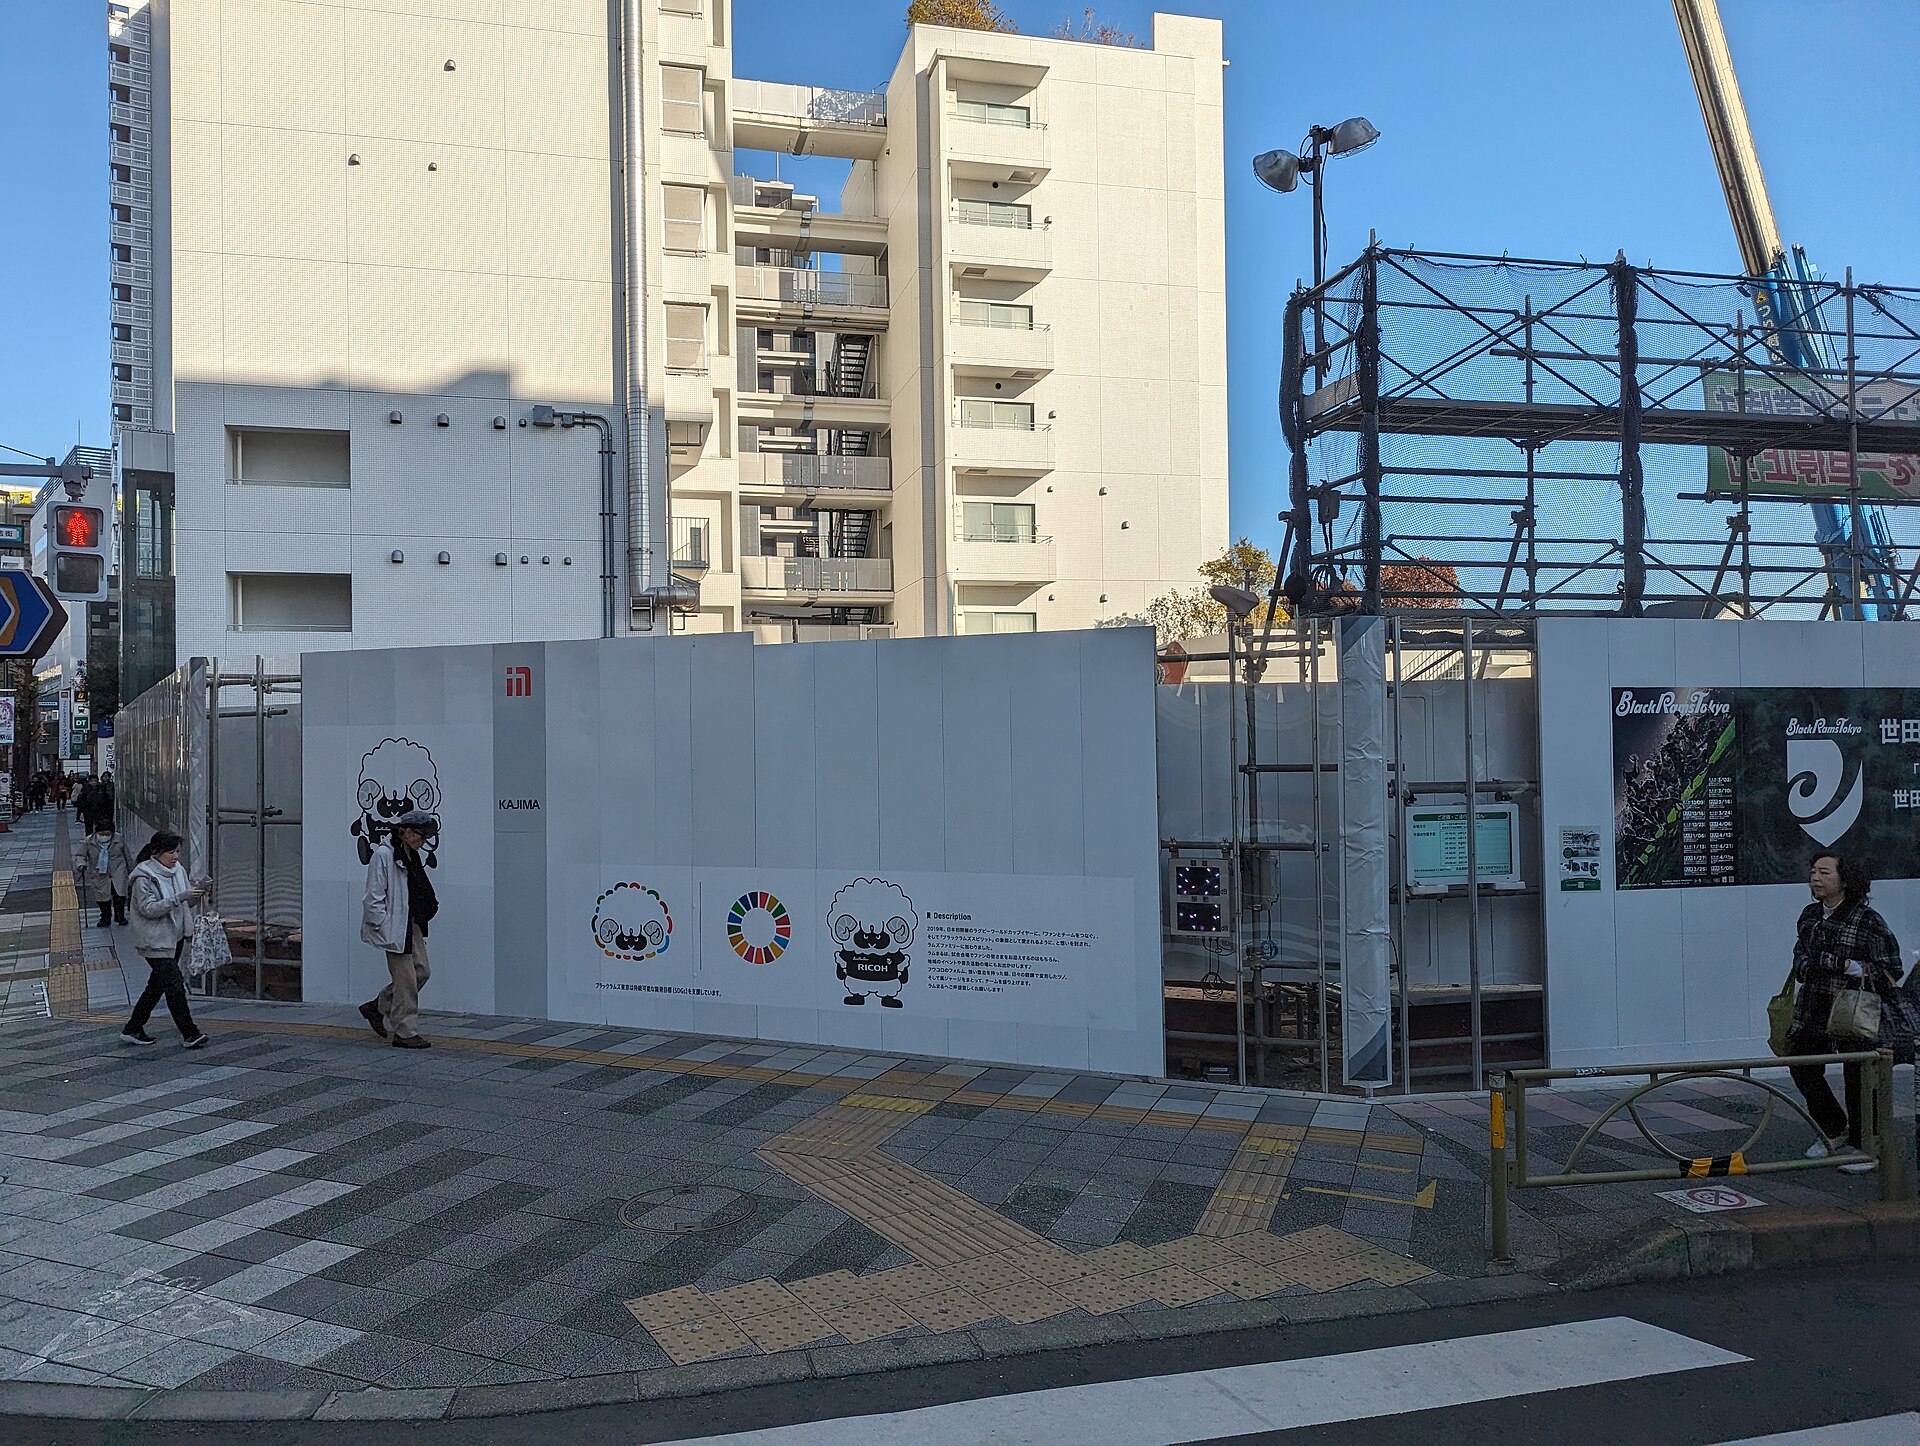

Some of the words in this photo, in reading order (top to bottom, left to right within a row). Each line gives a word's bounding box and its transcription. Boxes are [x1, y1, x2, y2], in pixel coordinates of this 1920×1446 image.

[499, 800, 540, 809] KAJIMA
[933, 912, 972, 921] Description
[857, 963, 888, 972] RICOH
